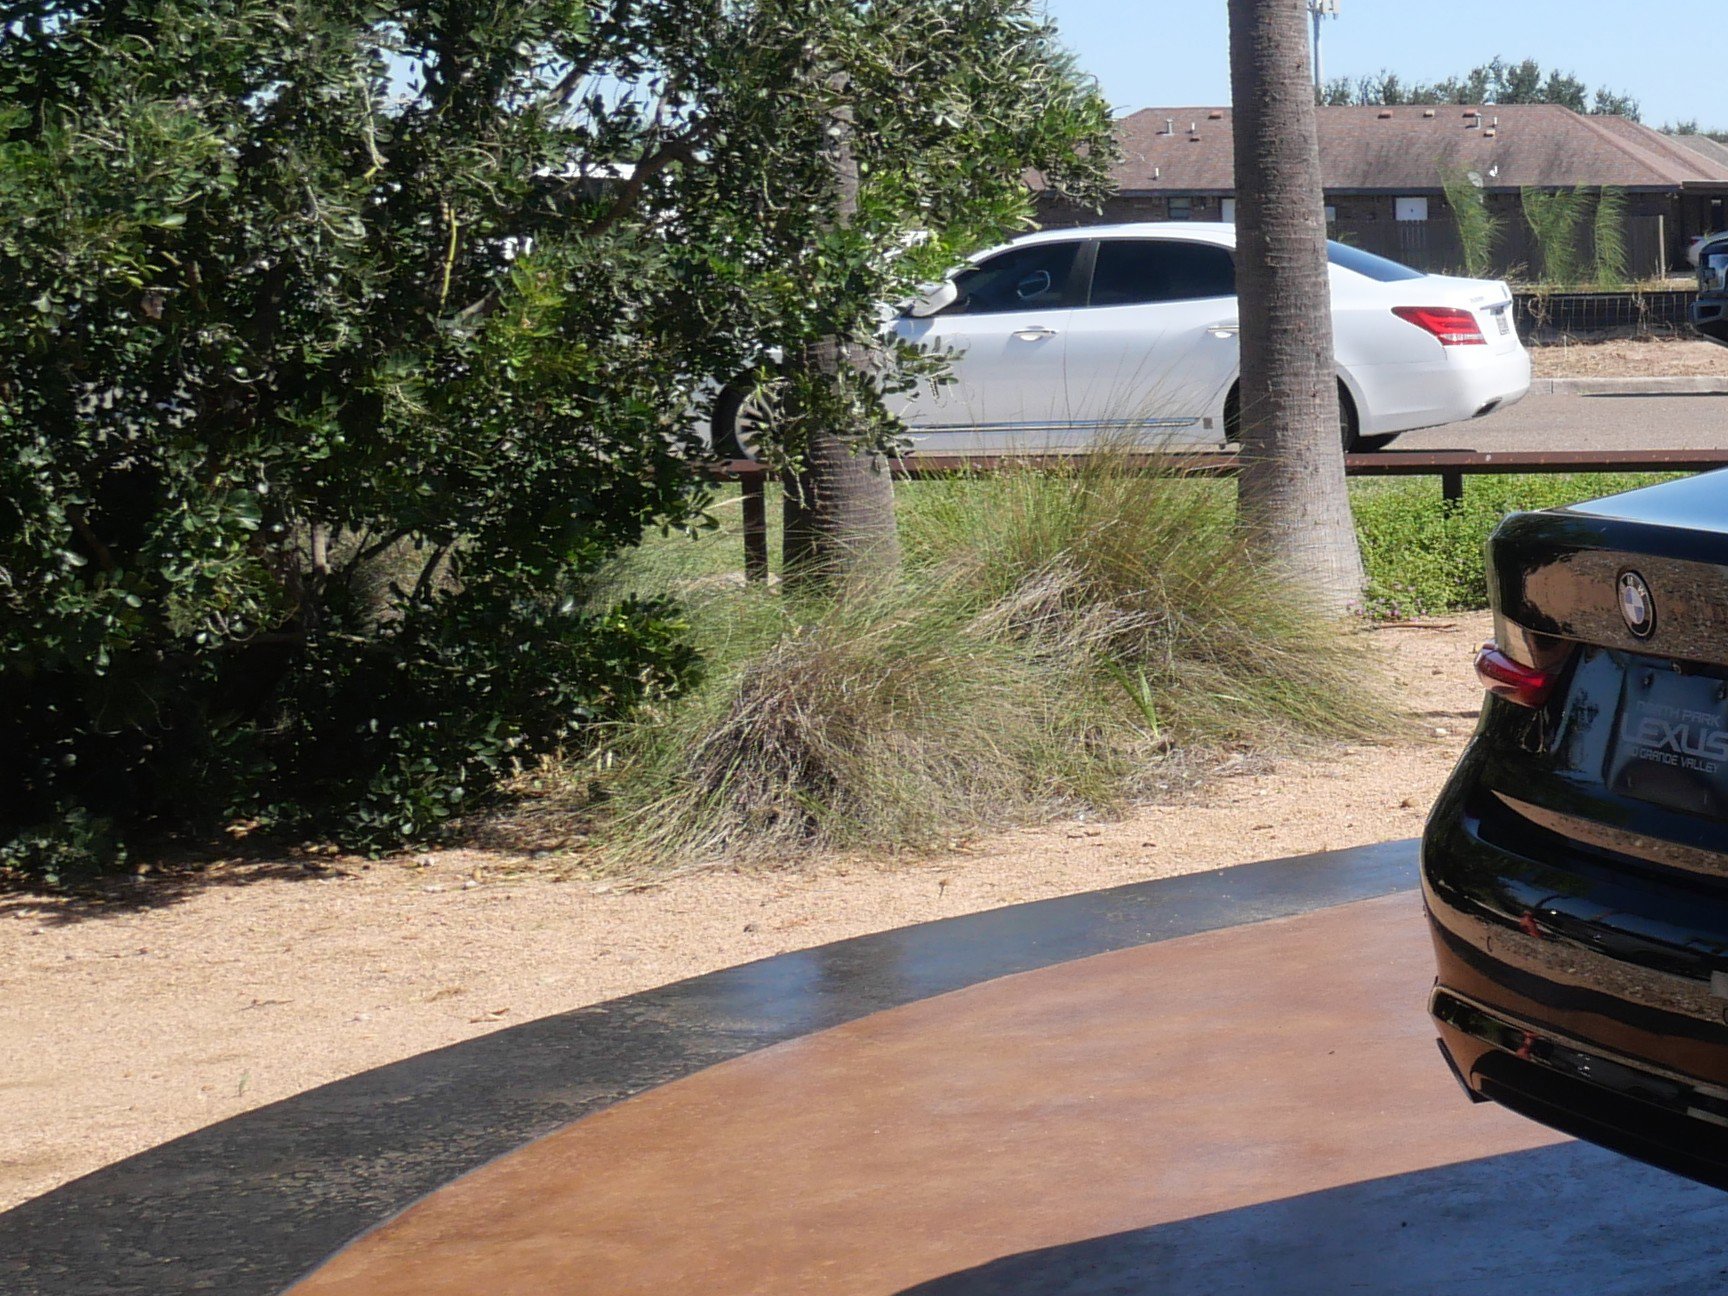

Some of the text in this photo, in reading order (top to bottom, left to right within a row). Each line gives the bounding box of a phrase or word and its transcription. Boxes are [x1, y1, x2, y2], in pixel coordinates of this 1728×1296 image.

[1681, 708, 1722, 728] PARK
[1639, 748, 1678, 766] GRANDE
[1680, 757, 1720, 774] VALLEY
